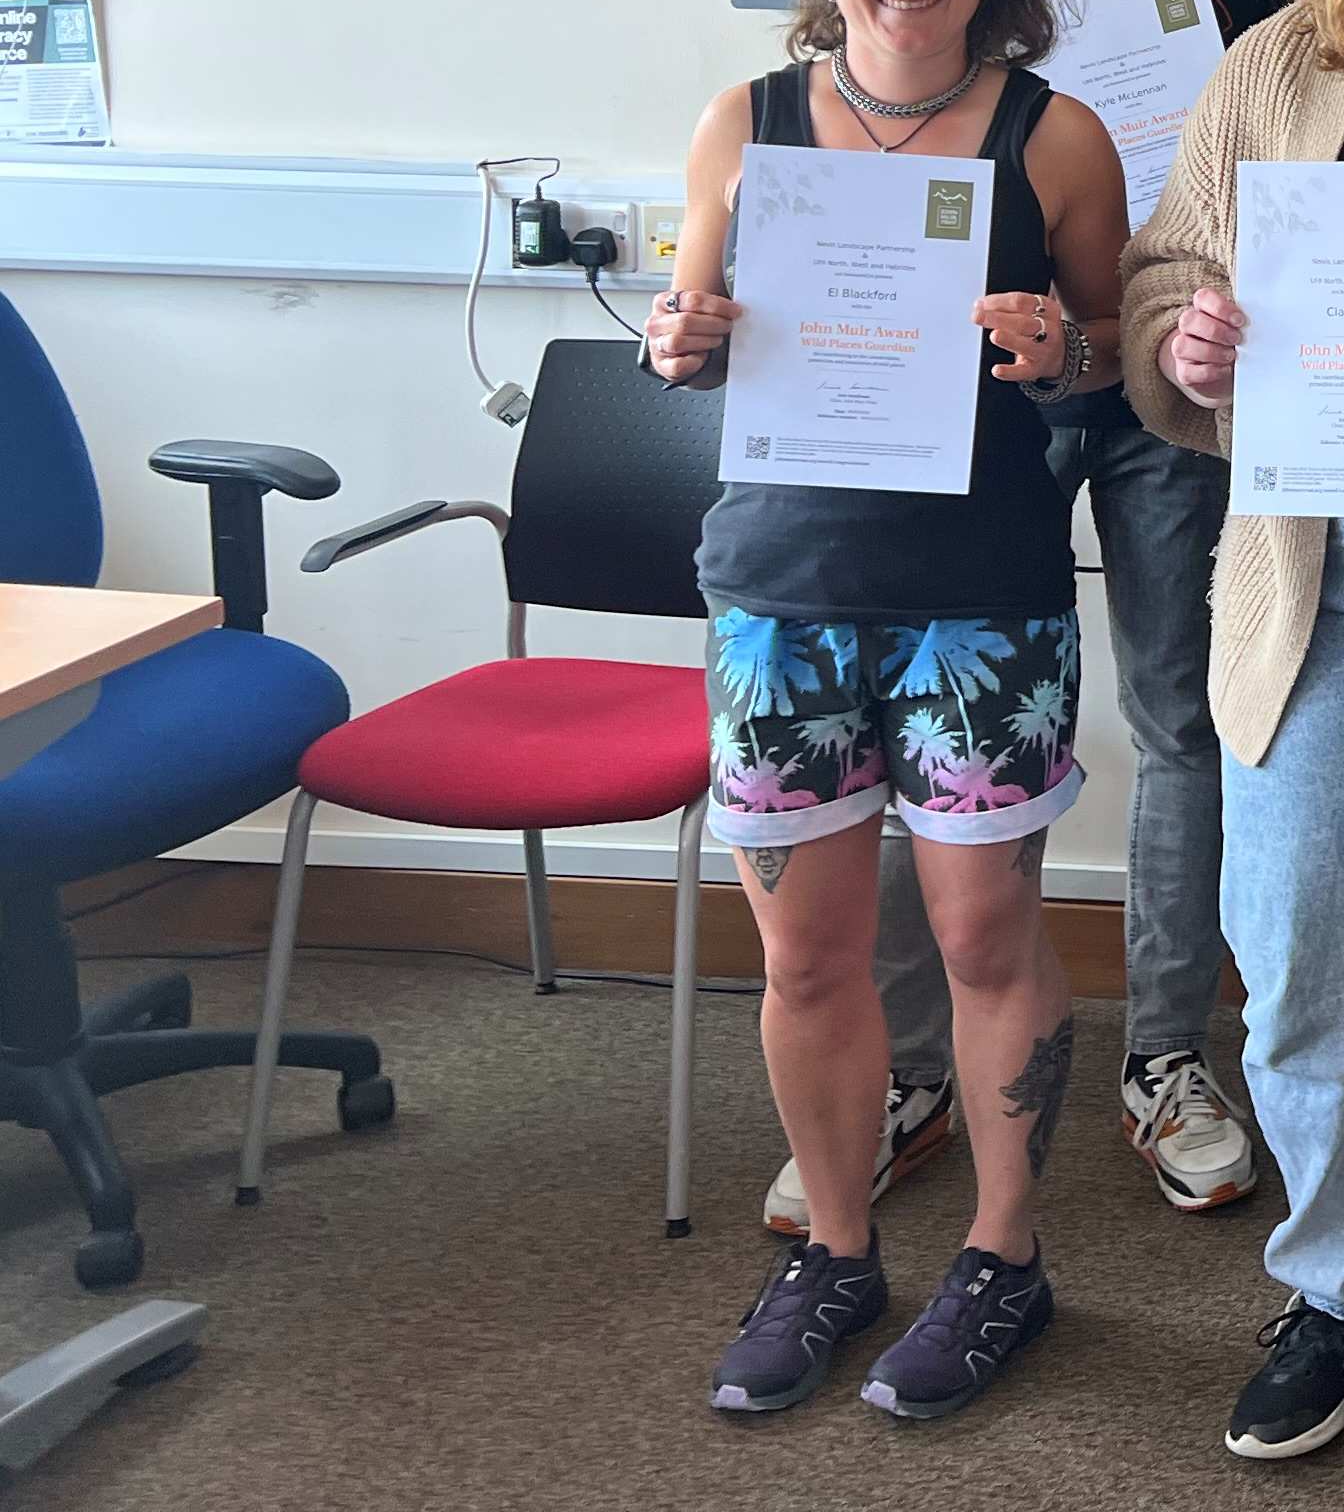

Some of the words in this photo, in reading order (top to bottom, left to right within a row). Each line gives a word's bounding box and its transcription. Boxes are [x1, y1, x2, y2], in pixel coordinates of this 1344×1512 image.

[1094, 96, 1116, 110] Kyle
[1117, 82, 1167, 102] McLennan
[1119, 117, 1149, 133] Muir
[1148, 106, 1188, 125] Award
[842, 287, 896, 301] Blackford
[799, 320, 832, 335] John
[836, 323, 870, 336] Muir
[873, 324, 919, 339] Award
[800, 336, 825, 347] Wild
[828, 338, 862, 349] Places
[864, 340, 915, 352] Guardian
[1299, 342, 1330, 356] John
[1301, 360, 1325, 369] Wild
